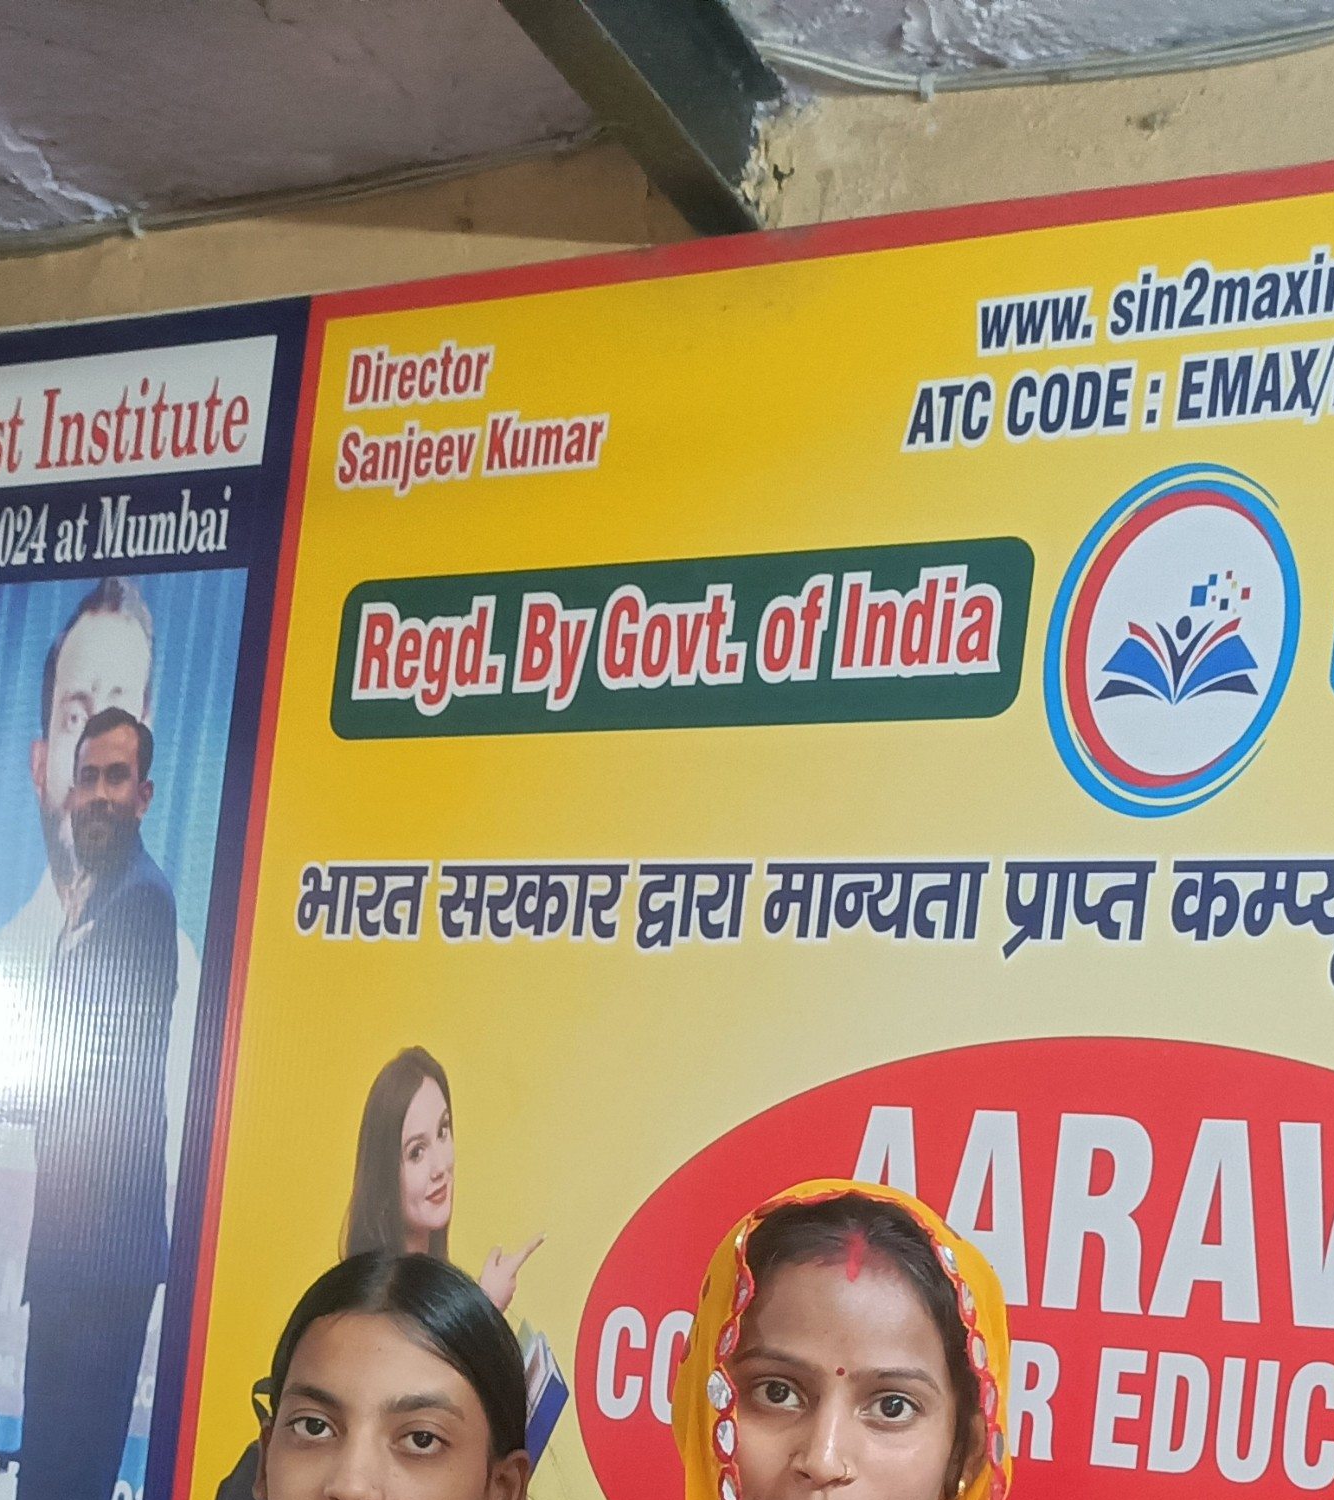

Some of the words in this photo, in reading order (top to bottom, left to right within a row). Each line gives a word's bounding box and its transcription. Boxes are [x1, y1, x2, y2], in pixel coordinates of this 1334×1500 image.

[979, 300, 1093, 349] www.
[348, 345, 490, 405] Director
[905, 382, 991, 446] ATC
[1005, 367, 1133, 435] CODE
[34, 377, 251, 470] Institute
[337, 428, 475, 493] Sanjeev
[485, 415, 605, 470] Kumar
[54, 510, 88, 563] at
[93, 486, 232, 560] Mumbai
[357, 604, 499, 708] Regd.
[518, 601, 588, 700] By
[604, 590, 740, 679] Govt.
[763, 582, 824, 672] of
[840, 573, 993, 669] India
[298, 866, 429, 937] भारत
[437, 864, 630, 937] सरकार
[637, 863, 754, 949] द्वारा
[765, 861, 989, 940] मान्यता
[1002, 860, 1156, 960] प्राप्त
